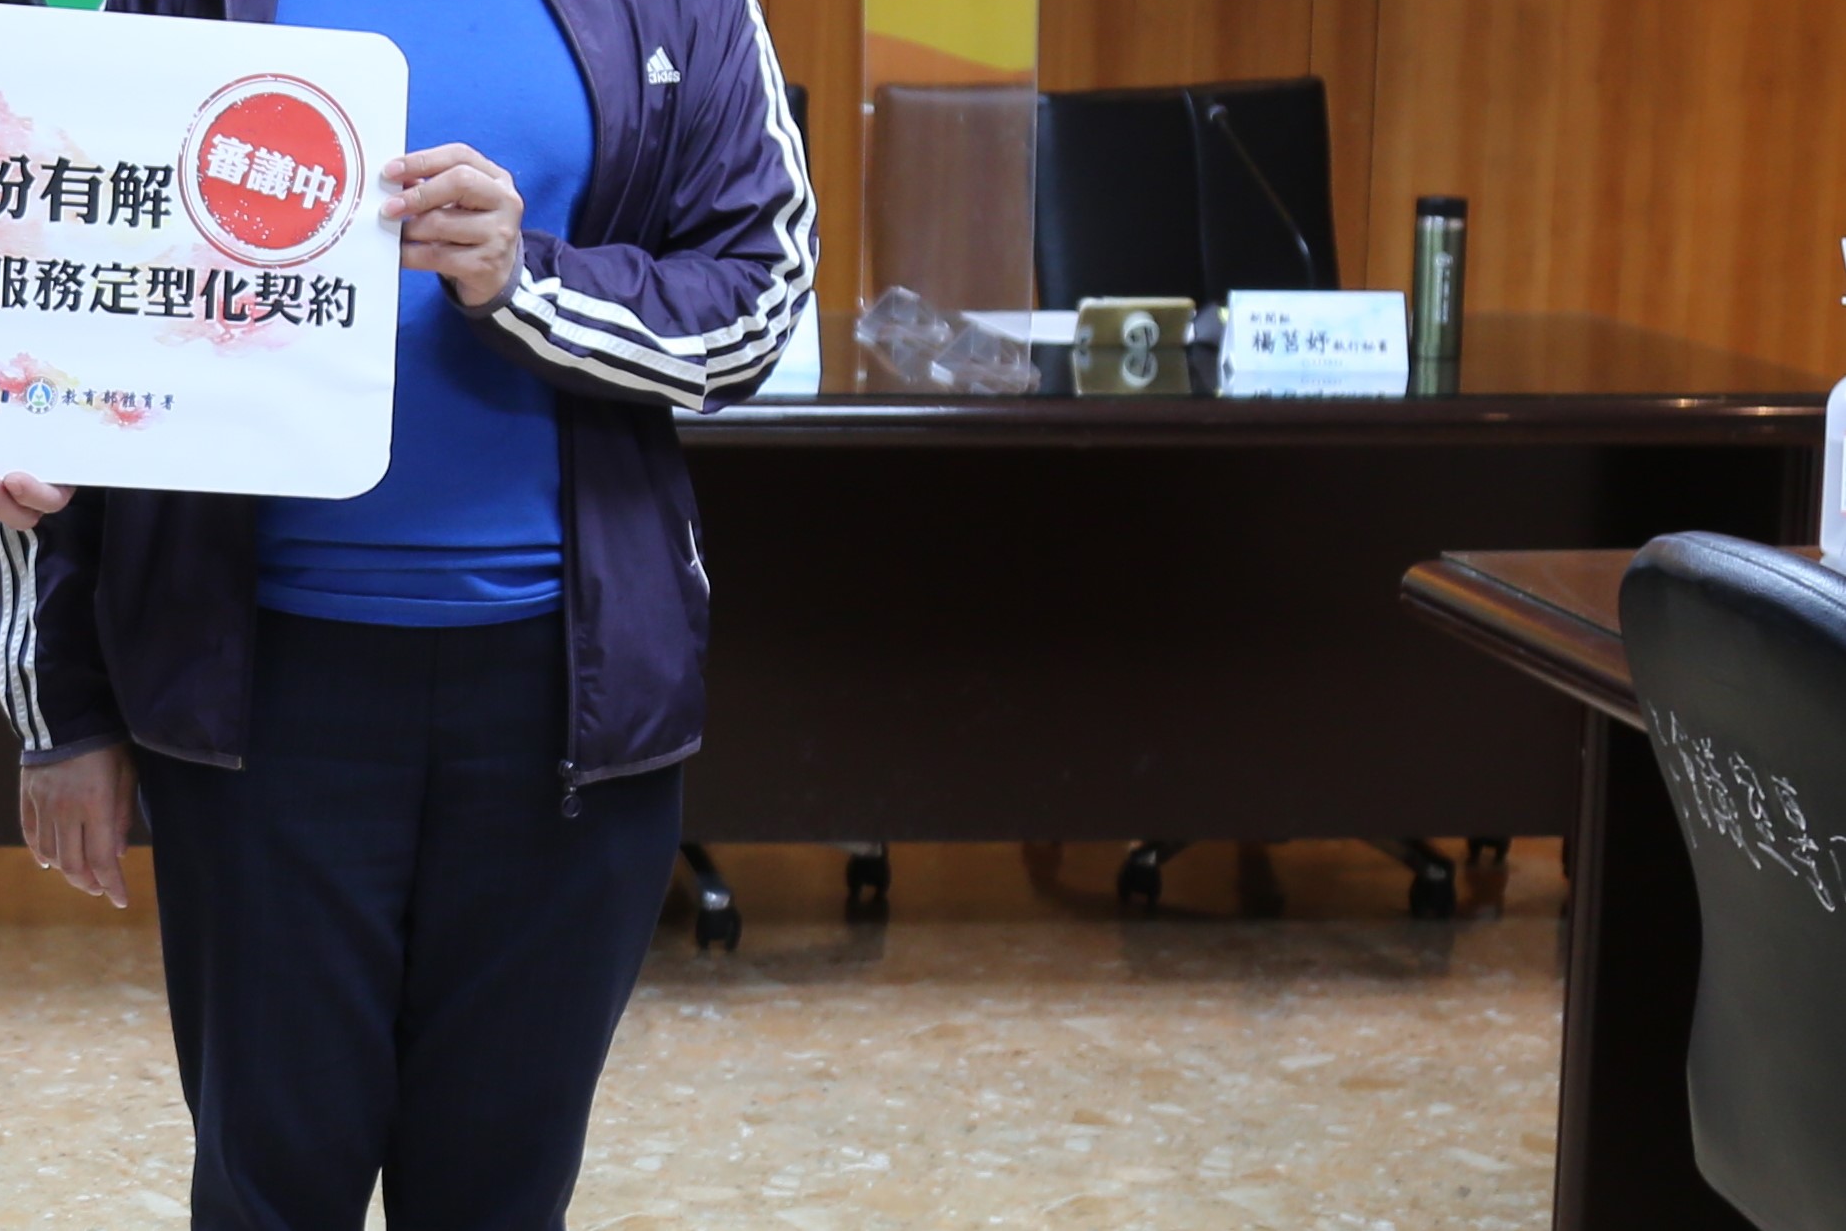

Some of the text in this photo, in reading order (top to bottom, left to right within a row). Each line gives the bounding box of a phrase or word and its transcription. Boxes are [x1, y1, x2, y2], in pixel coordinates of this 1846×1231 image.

[207, 133, 338, 210] 審議中
[61, 387, 175, 411] 教育部體育署
